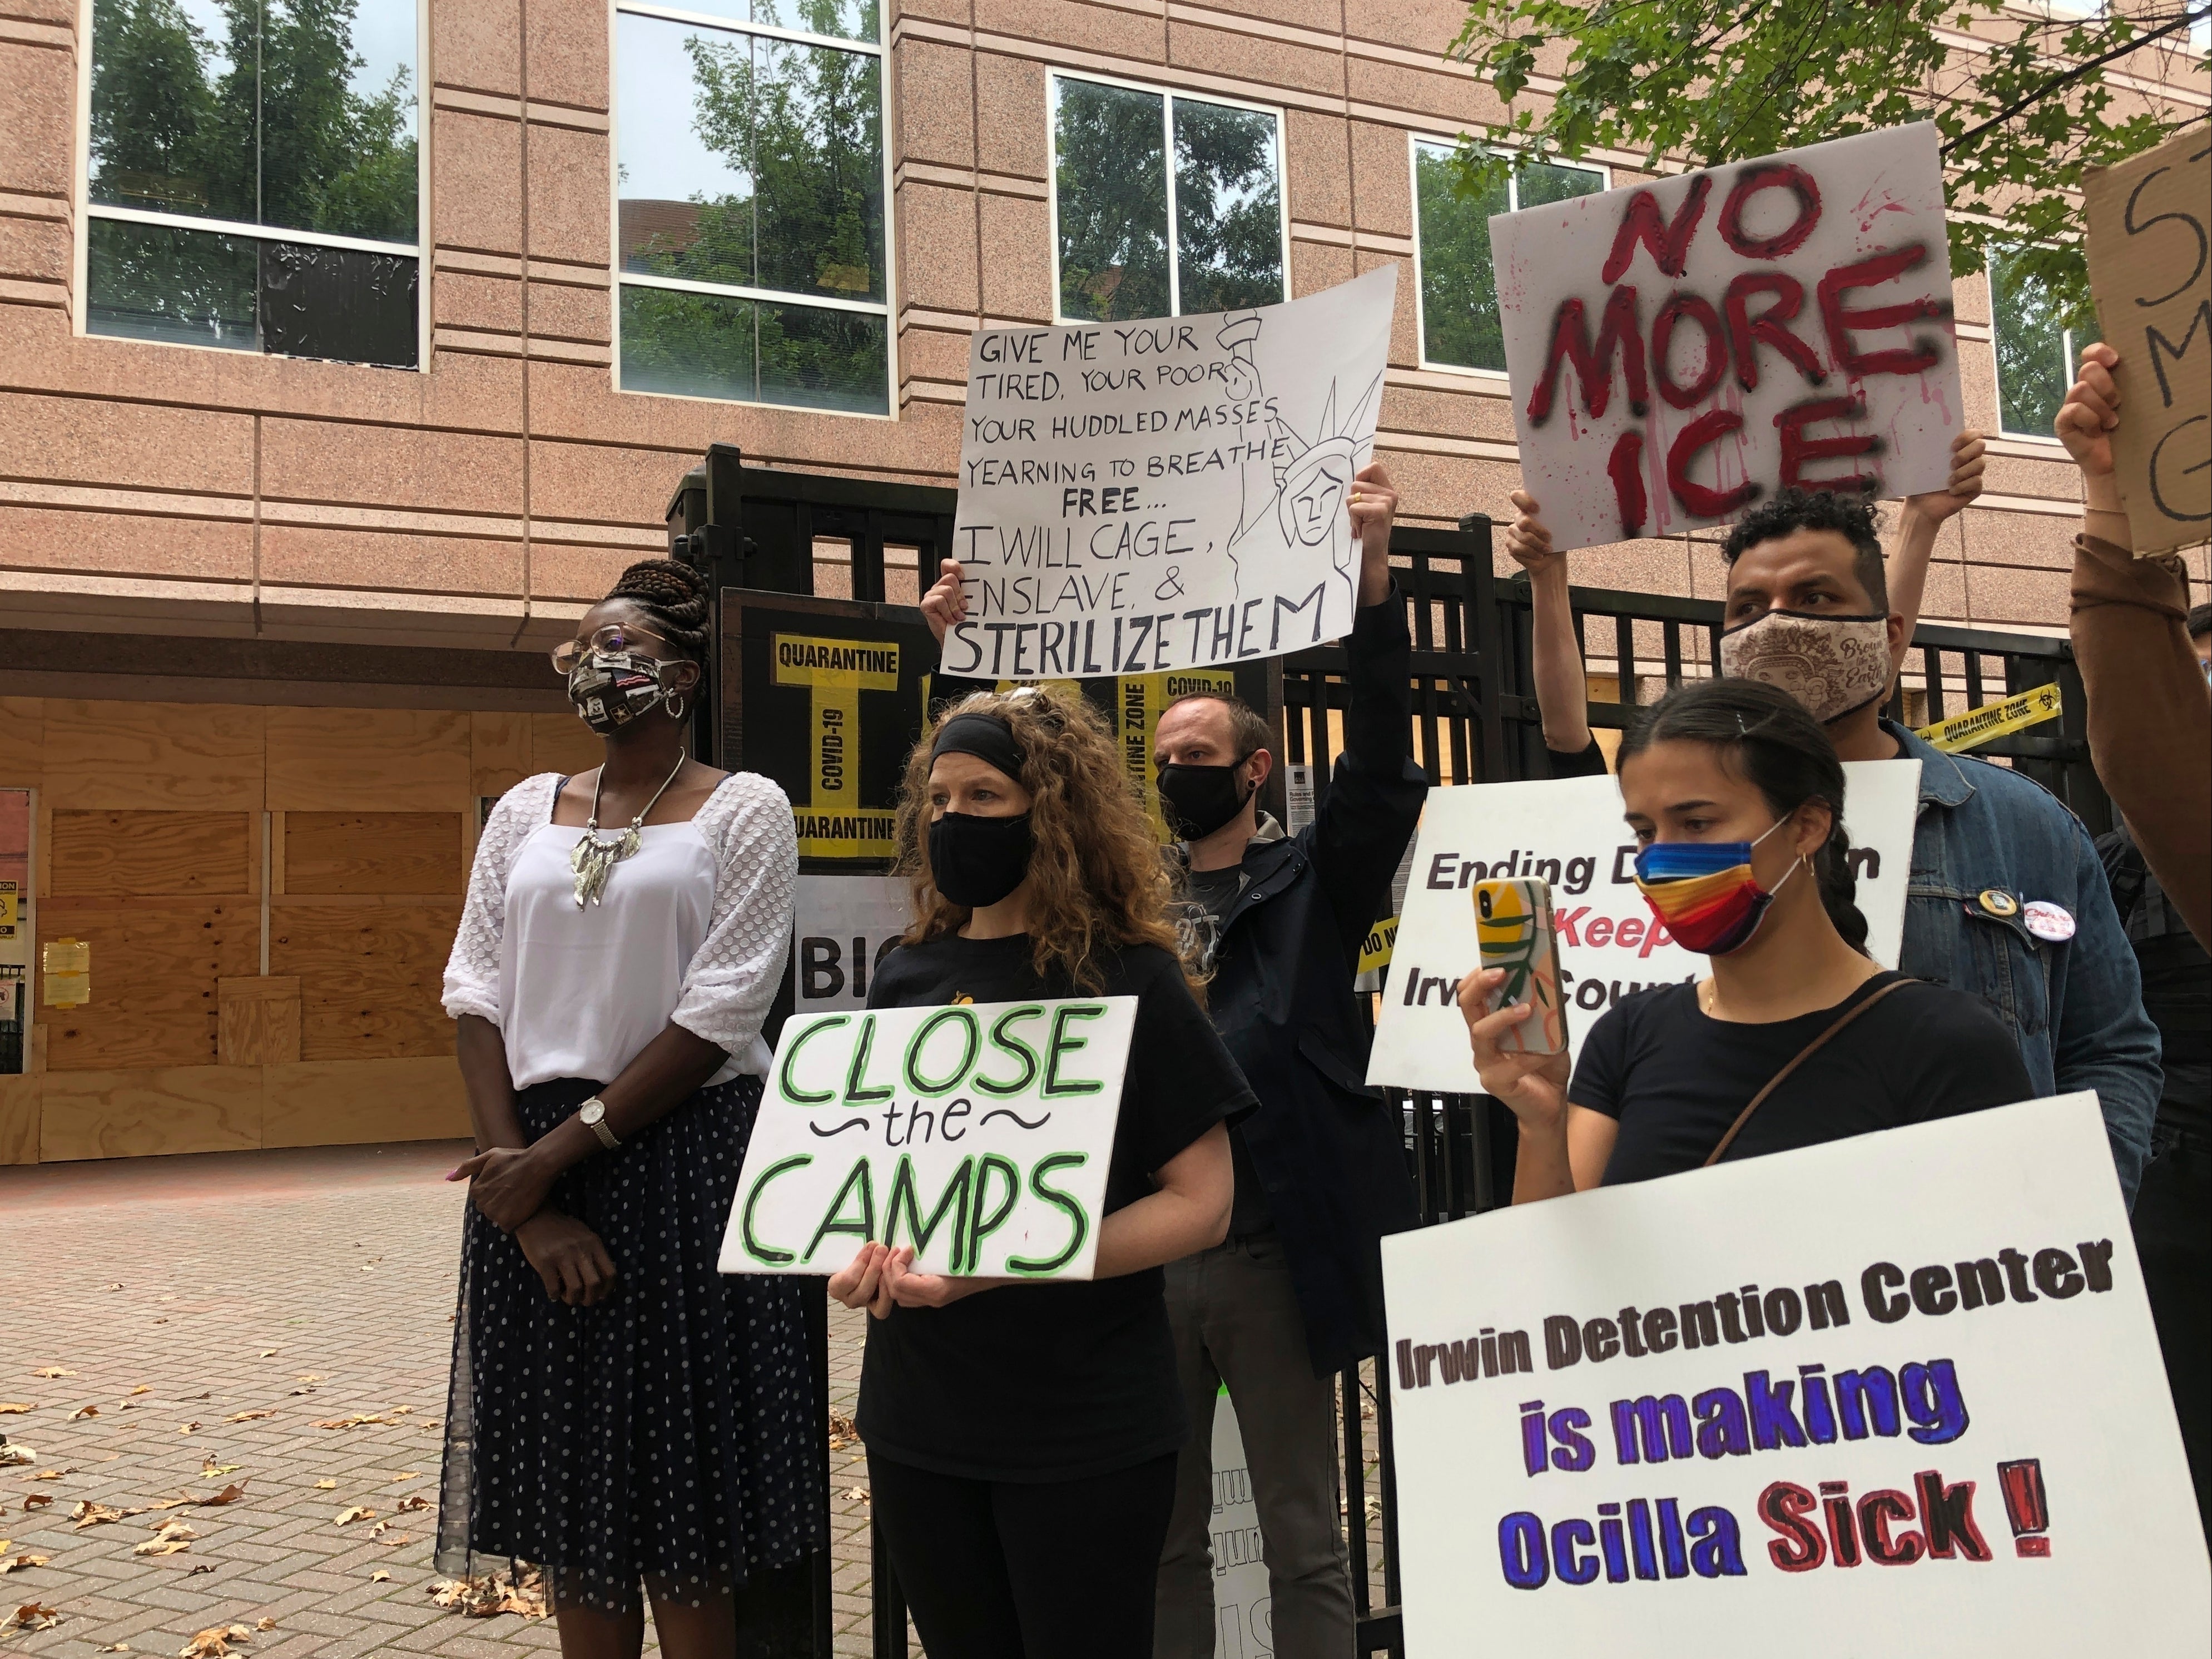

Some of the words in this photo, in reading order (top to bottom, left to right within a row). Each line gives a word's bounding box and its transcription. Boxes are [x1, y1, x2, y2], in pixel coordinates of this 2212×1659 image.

[1602, 162, 1822, 284] NO
[2125, 146, 2211, 307] S
[980, 333, 1048, 366] GIVE
[1063, 330, 1100, 360] ME
[1113, 325, 1198, 356] YOUR
[1527, 244, 1952, 426] MORE
[976, 374, 1064, 402] TIRED,
[1081, 368, 1145, 393] YOUR
[971, 417, 1035, 444] YOUR
[1053, 409, 1167, 436] HUDDLED
[1174, 397, 1278, 432] MASSES
[967, 457, 1095, 488] YEARNING
[1109, 459, 1134, 478] TO
[1148, 438, 1287, 478] BREATHE
[1608, 396, 1884, 538] ICE
[1063, 487, 1167, 518] FREE...
[959, 526, 994, 566] I
[1000, 524, 1082, 569] WILL
[1155, 566, 1185, 601] &
[948, 615, 1174, 675] STERILIZE
[1183, 581, 1326, 661] THEM
[780, 643, 897, 673] QUARANTINE
[1846, 662, 1882, 688] Earth
[1125, 684, 1145, 730] ZONE
[1168, 676, 1232, 696] COVID-19
[1945, 707, 2005, 742] QUARANTINE
[2004, 699, 2031, 720] ZONE
[822, 709, 843, 790] COVID-19
[794, 816, 895, 839] UARANTINE
[1427, 850, 1596, 894] Ending
[1363, 933, 1382, 956] DO
[780, 1004, 1108, 1107] CLOSE
[882, 1098, 972, 1146] the
[740, 1152, 1089, 1276] CAMPS
[1394, 1326, 1532, 1390] Irwin
[1542, 1280, 1852, 1373] Detention
[1861, 1238, 2115, 1324] Center
[1518, 1400, 1596, 1478] is
[1609, 1358, 1971, 1465] making
[1496, 1498, 1749, 1591] Ocilla
